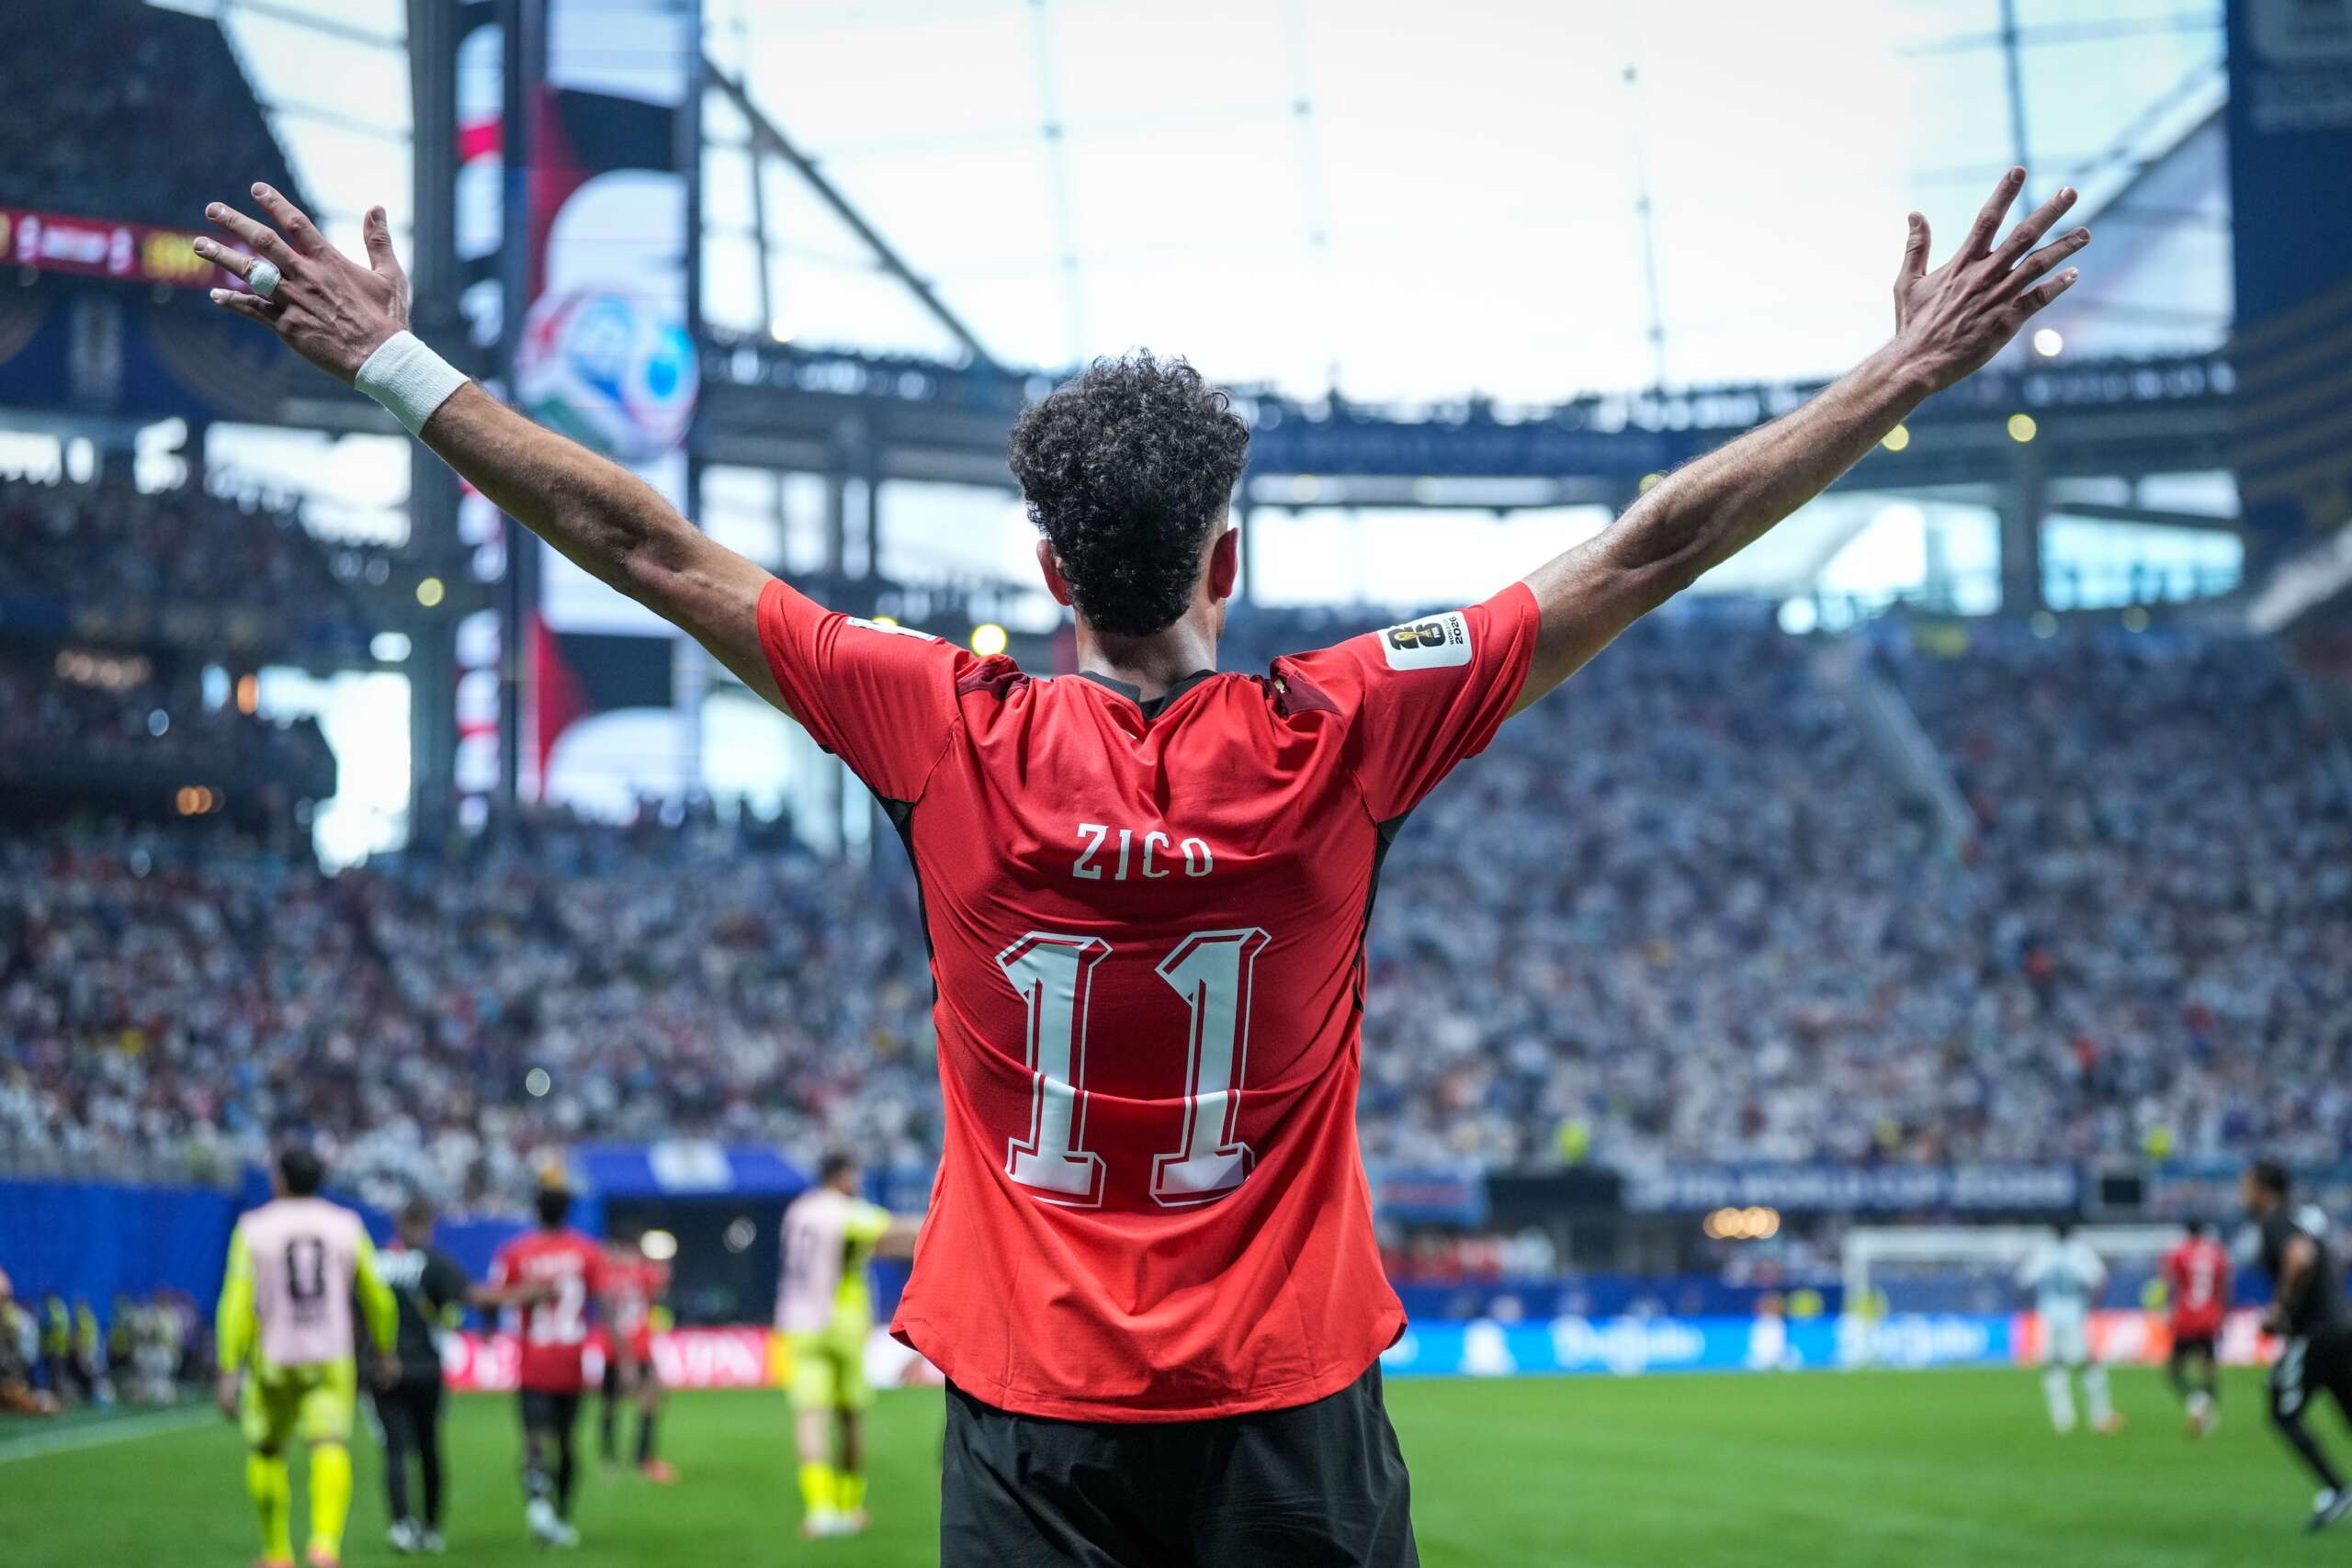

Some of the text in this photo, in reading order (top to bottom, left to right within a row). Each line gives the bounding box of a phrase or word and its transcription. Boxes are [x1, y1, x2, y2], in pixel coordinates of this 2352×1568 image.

[1449, 616, 1464, 645] 2026
[1072, 823, 1213, 880] ZICO
[995, 927, 1272, 1208] 11
